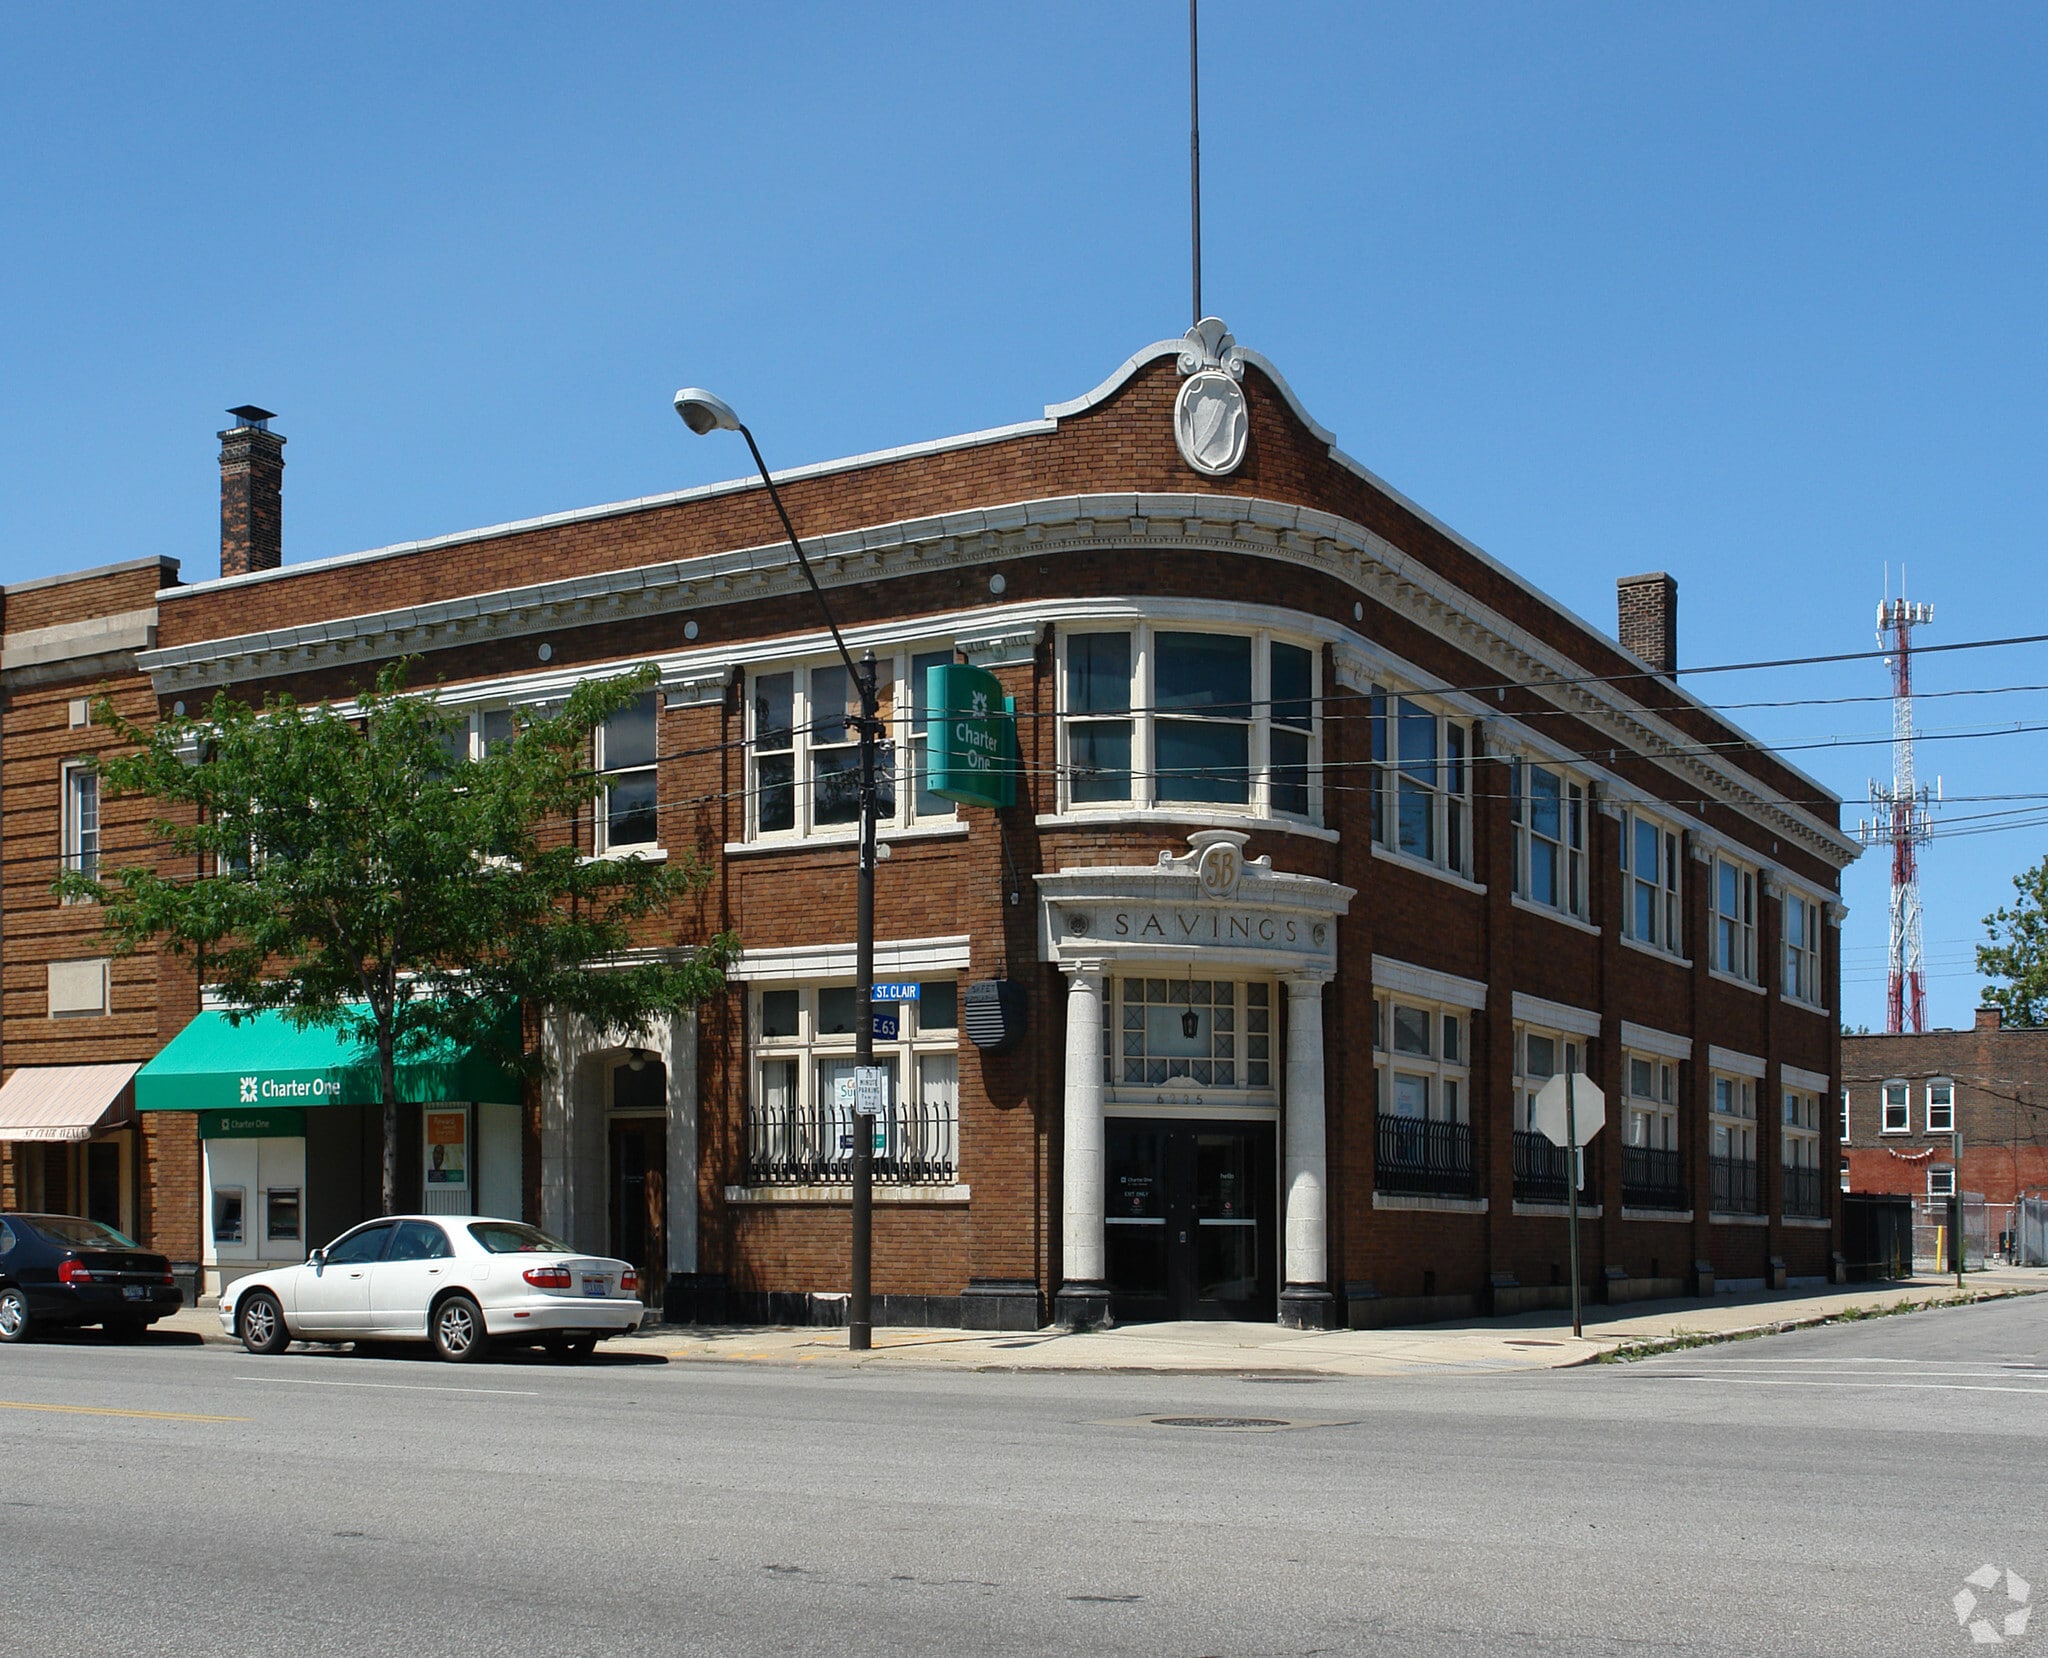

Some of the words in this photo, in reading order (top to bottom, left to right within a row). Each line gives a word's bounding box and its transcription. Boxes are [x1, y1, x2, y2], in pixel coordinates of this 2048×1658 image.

[956, 723, 998, 753] Charter
[967, 749, 991, 771] One
[1206, 852, 1235, 888] SB
[1115, 913, 1297, 942] SAVINGS
[876, 985, 889, 998] ST.
[890, 985, 916, 998] CLAIR
[261, 1079, 311, 1098] Charter
[312, 1078, 341, 1096] One
[231, 1119, 255, 1129] Charter
[255, 1119, 270, 1128] One
